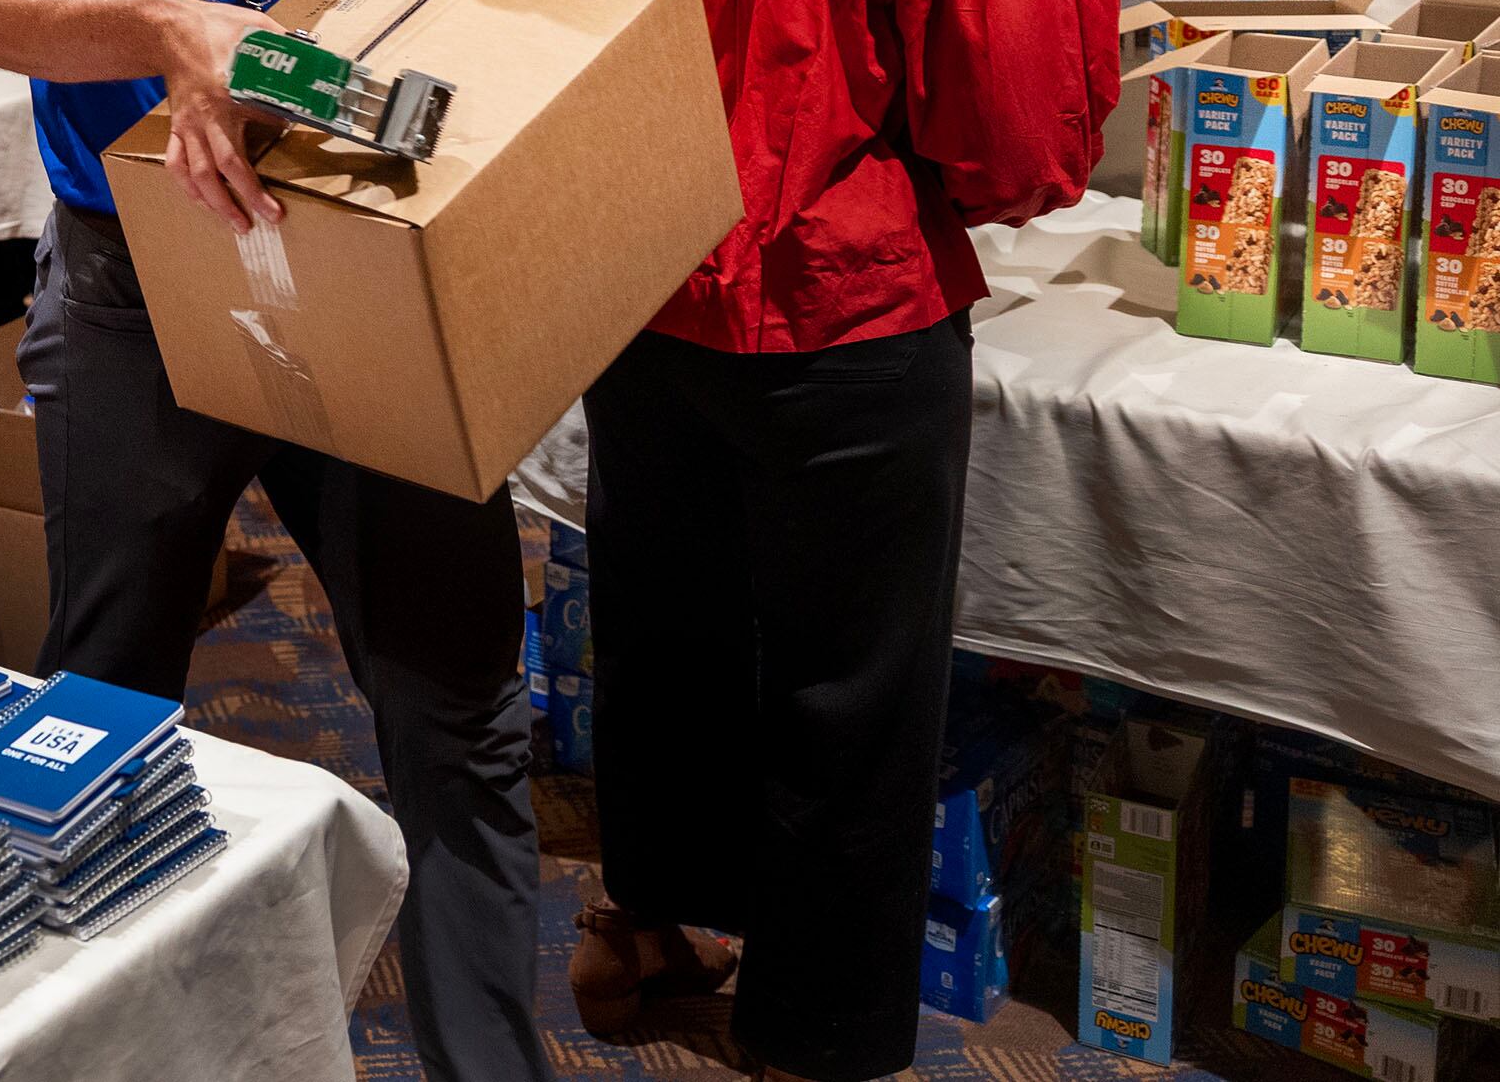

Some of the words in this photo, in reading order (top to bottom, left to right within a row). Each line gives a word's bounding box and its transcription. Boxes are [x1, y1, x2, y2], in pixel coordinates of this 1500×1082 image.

[1256, 77, 1280, 91] 60
[1385, 101, 1410, 110] BARS
[1198, 109, 1238, 121] VARIETY
[1204, 121, 1231, 131] PACK
[1324, 120, 1366, 132] VARIETY
[1332, 130, 1358, 143] PACK
[1440, 136, 1483, 150] VARIETY
[1200, 149, 1225, 165] 30
[1447, 148, 1475, 160] PACK
[1326, 161, 1353, 177] 30
[1441, 178, 1469, 196] 30
[1441, 195, 1476, 206] CHOCOLATE
[1195, 224, 1220, 240] 30
[1321, 237, 1348, 254] 30
[1436, 257, 1463, 275] 30
[30, 732, 79, 754] USA
[1, 748, 25, 759] ONE
[24, 754, 48, 766] FOR
[45, 760, 66, 772] ALL
[1372, 938, 1396, 952] 30
[1370, 965, 1394, 978] 30
[1315, 997, 1337, 1014] 30
[1314, 1023, 1335, 1038] 30
